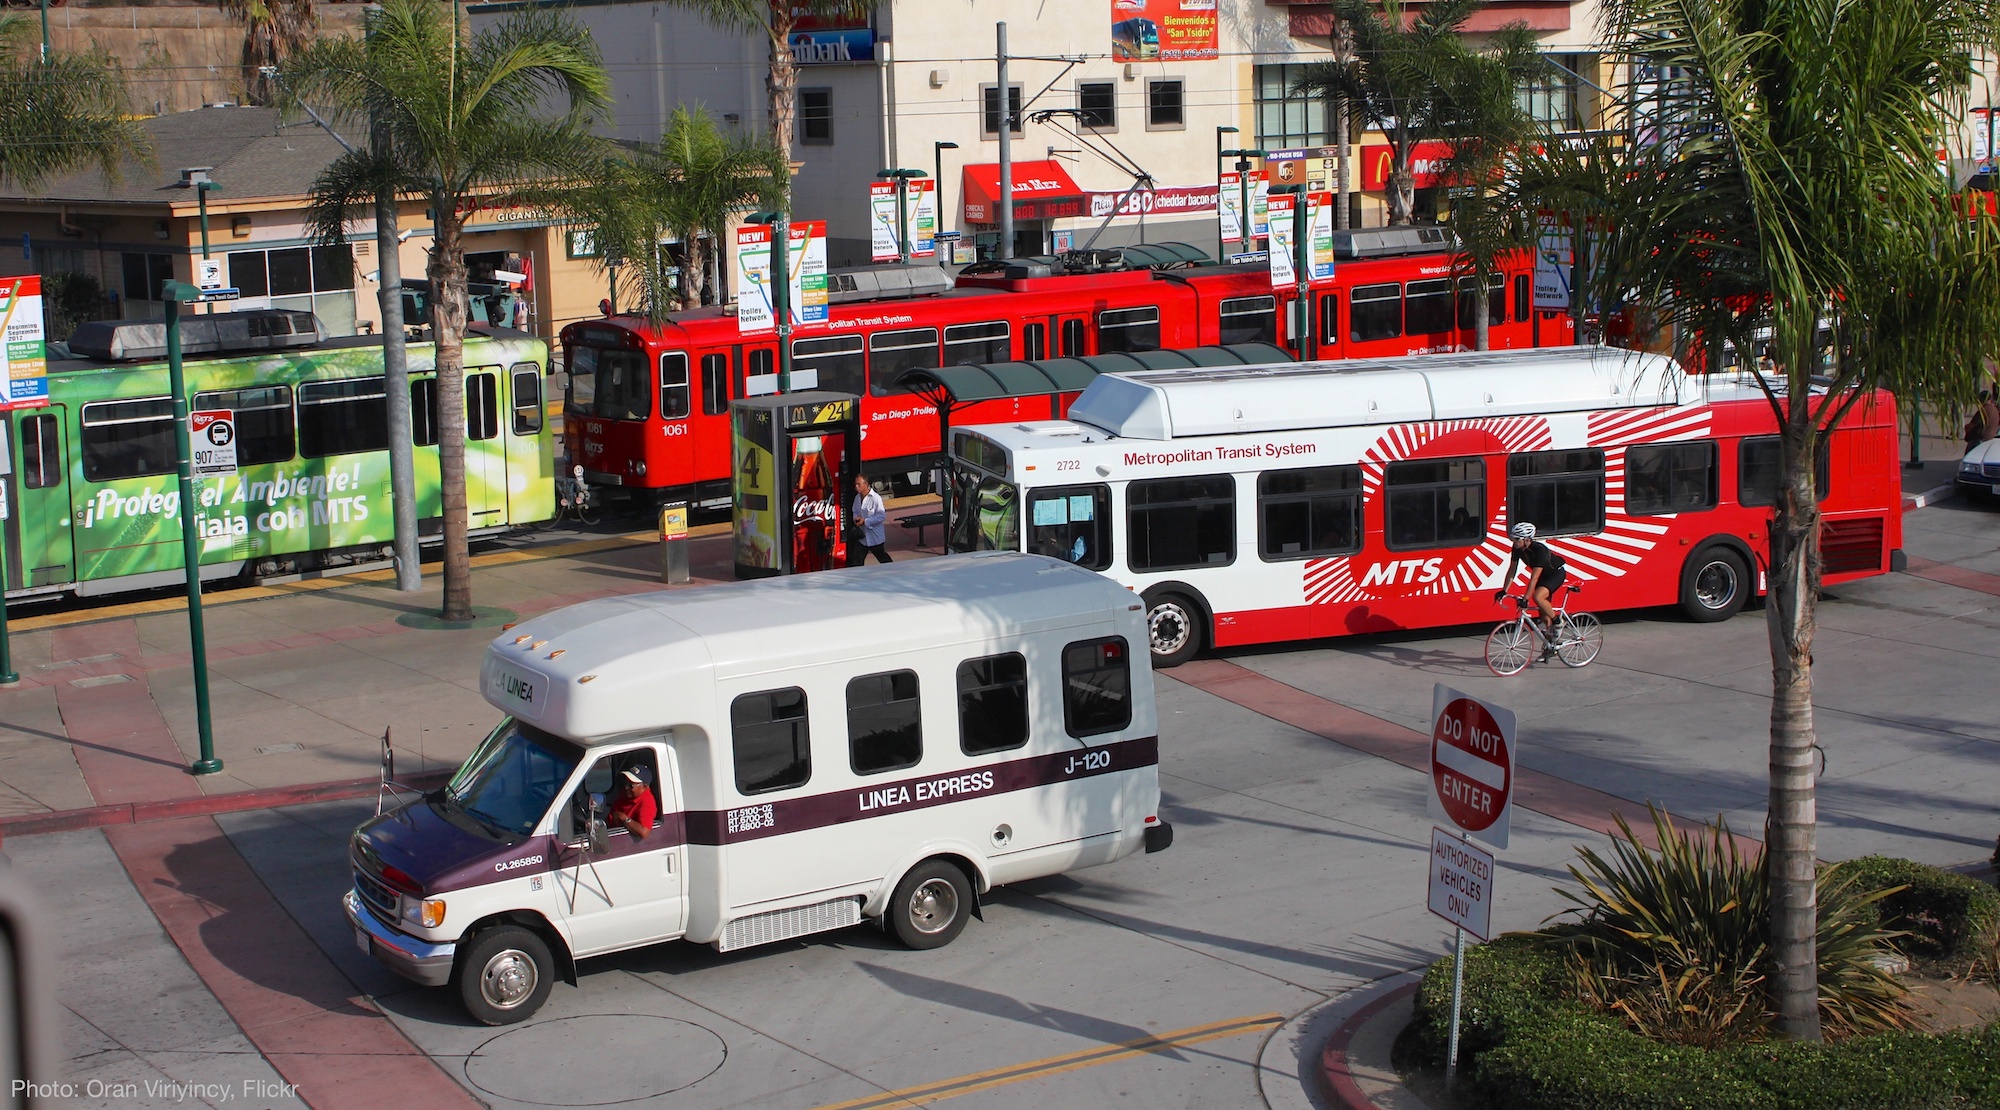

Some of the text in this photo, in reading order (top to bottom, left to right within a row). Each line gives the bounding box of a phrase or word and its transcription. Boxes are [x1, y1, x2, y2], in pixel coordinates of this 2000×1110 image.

[1164, 15, 1216, 25] Bienvenidos a
[1280, 166, 1294, 181] ups
[966, 204, 984, 212] CHECKS
[1094, 197, 1113, 212] new
[1117, 192, 1153, 213] CBO
[1154, 190, 1187, 208] (cheddar
[1187, 189, 1210, 206] bacon
[1268, 201, 1288, 210] NEW!
[966, 211, 984, 219] CASHED
[739, 232, 765, 243] NEW!
[1058, 237, 1068, 248] NO
[0, 287, 10, 295] TS
[1534, 285, 1557, 293] Trolley
[1535, 291, 1563, 300] Network
[740, 308, 762, 316] Trolley
[740, 314, 768, 323] Network
[8, 323, 38, 331] Beginning
[856, 316, 882, 326] Transit
[883, 314, 912, 325] System
[8, 328, 40, 336] September
[827, 402, 845, 421] 24
[872, 406, 937, 421] San Diego Trolley
[587, 422, 603, 434] 1061
[662, 423, 688, 436] 1061
[195, 450, 212, 464] 907
[1123, 441, 1316, 466] Metropolitan Transit System
[1056, 459, 1081, 471] 2722
[84, 486, 181, 529] ¡Proteg
[201, 477, 225, 507] el
[231, 462, 360, 507] Ambiente!
[256, 504, 304, 532] con
[313, 495, 369, 526] MTS
[1361, 556, 1443, 588] MTS
[507, 675, 533, 703] LINEA
[1443, 714, 1500, 757] DO NOT
[1065, 750, 1111, 775] J-120
[859, 770, 994, 811] LINEA EXPRESS
[1442, 773, 1492, 815] ENTER
[727, 804, 773, 818] RT.5100-02
[727, 812, 773, 826] RT.6700-10
[728, 819, 774, 834] RT.6800-02
[495, 854, 543, 873] CA.265850
[1435, 839, 1489, 881] AUTHORIZED
[532, 879, 542, 890] 15
[1440, 865, 1482, 902] VEHICLES
[1448, 893, 1470, 920] ONLY
